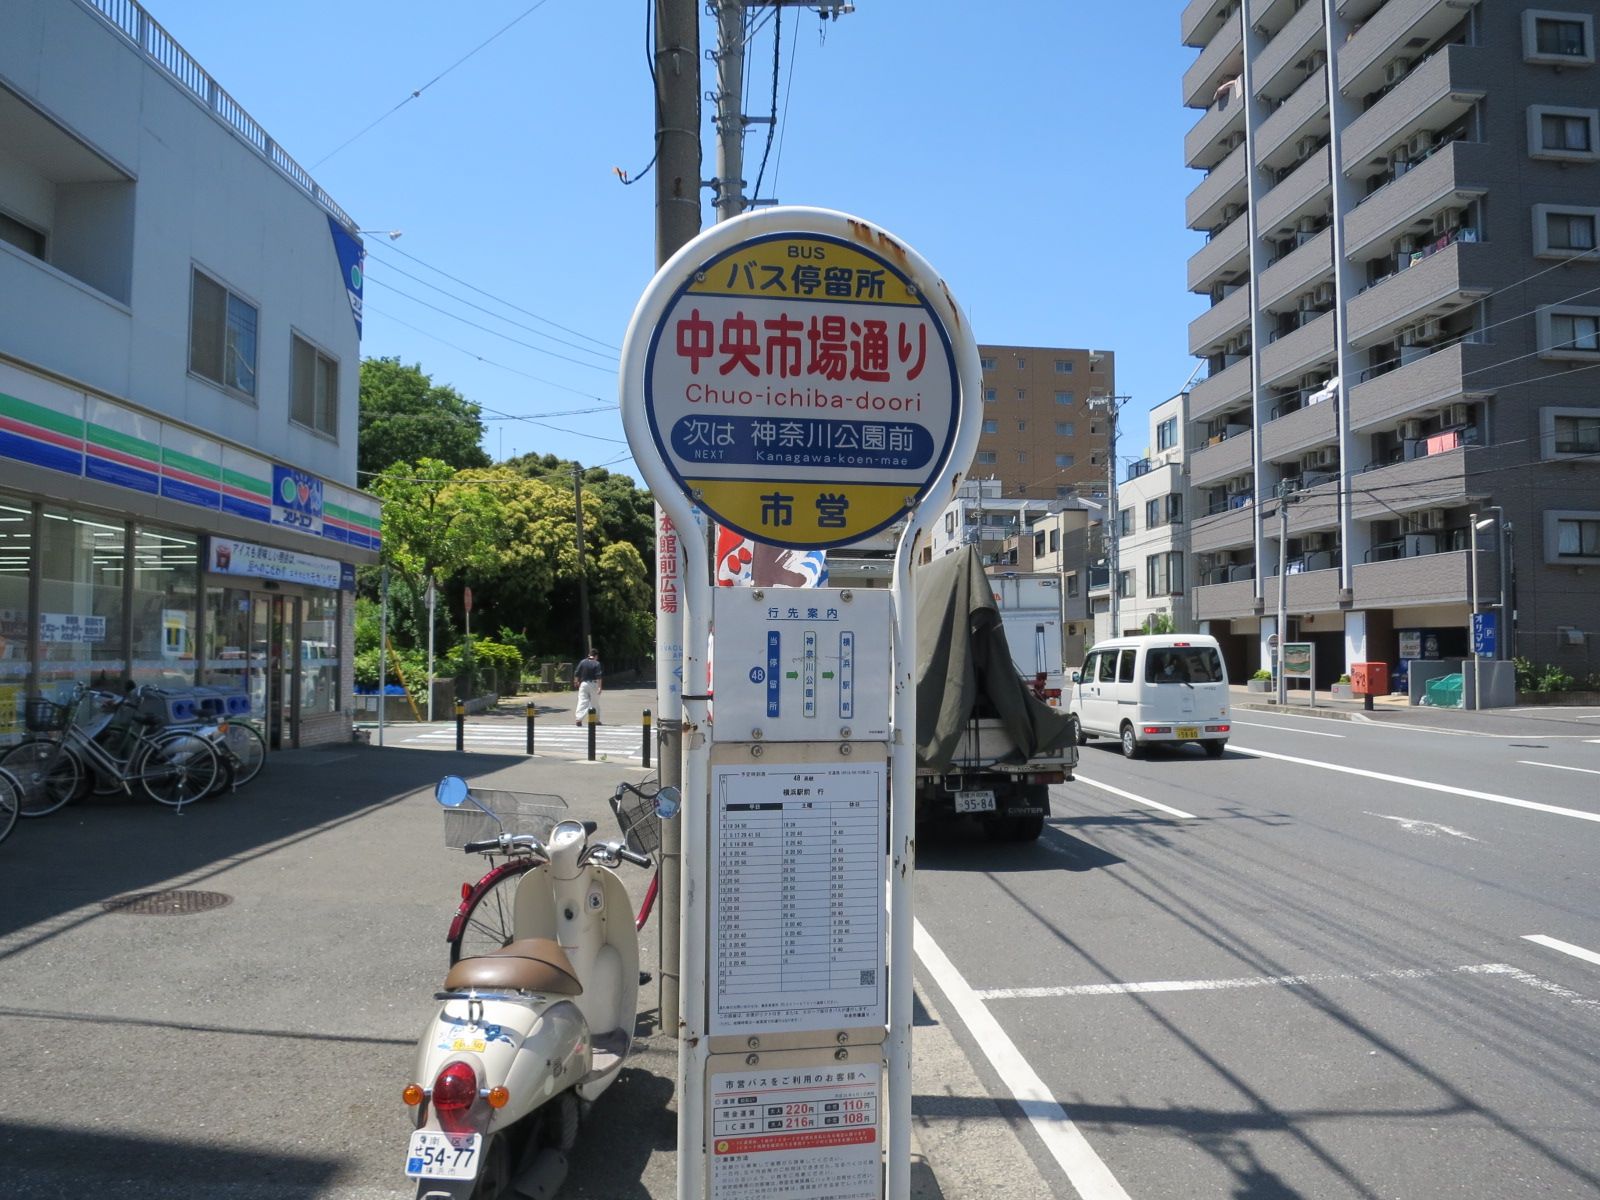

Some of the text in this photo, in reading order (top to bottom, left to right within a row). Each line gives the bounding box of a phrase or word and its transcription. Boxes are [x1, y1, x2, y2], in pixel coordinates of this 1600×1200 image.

[788, 246, 825, 260] BUS
[727, 261, 885, 299] バス停留所
[676, 308, 927, 383] 中央市場通り
[686, 384, 922, 412] Chuo-ichiba-doori
[683, 419, 914, 452] 次は 神奈川公園前
[694, 450, 908, 467] NEXT Kanagawa-koen-mae
[760, 492, 849, 528] 市営
[660, 509, 678, 614] 本館前広場
[768, 607, 838, 619] 行先案内
[751, 670, 764, 680] 48
[768, 636, 778, 712] 当停留所
[806, 637, 814, 712] 神奈川公園前
[842, 637, 850, 712] 横浜駅前
[965, 798, 993, 810] 95-84
[726, 1072, 866, 1090] 市営バスをご利用のお客様へ
[786, 1104, 814, 1115] 220円
[843, 1100, 870, 1110] 110円
[786, 1117, 814, 1128] 216円
[843, 1113, 870, 1124] 108円
[424, 1147, 475, 1168] 54-77
